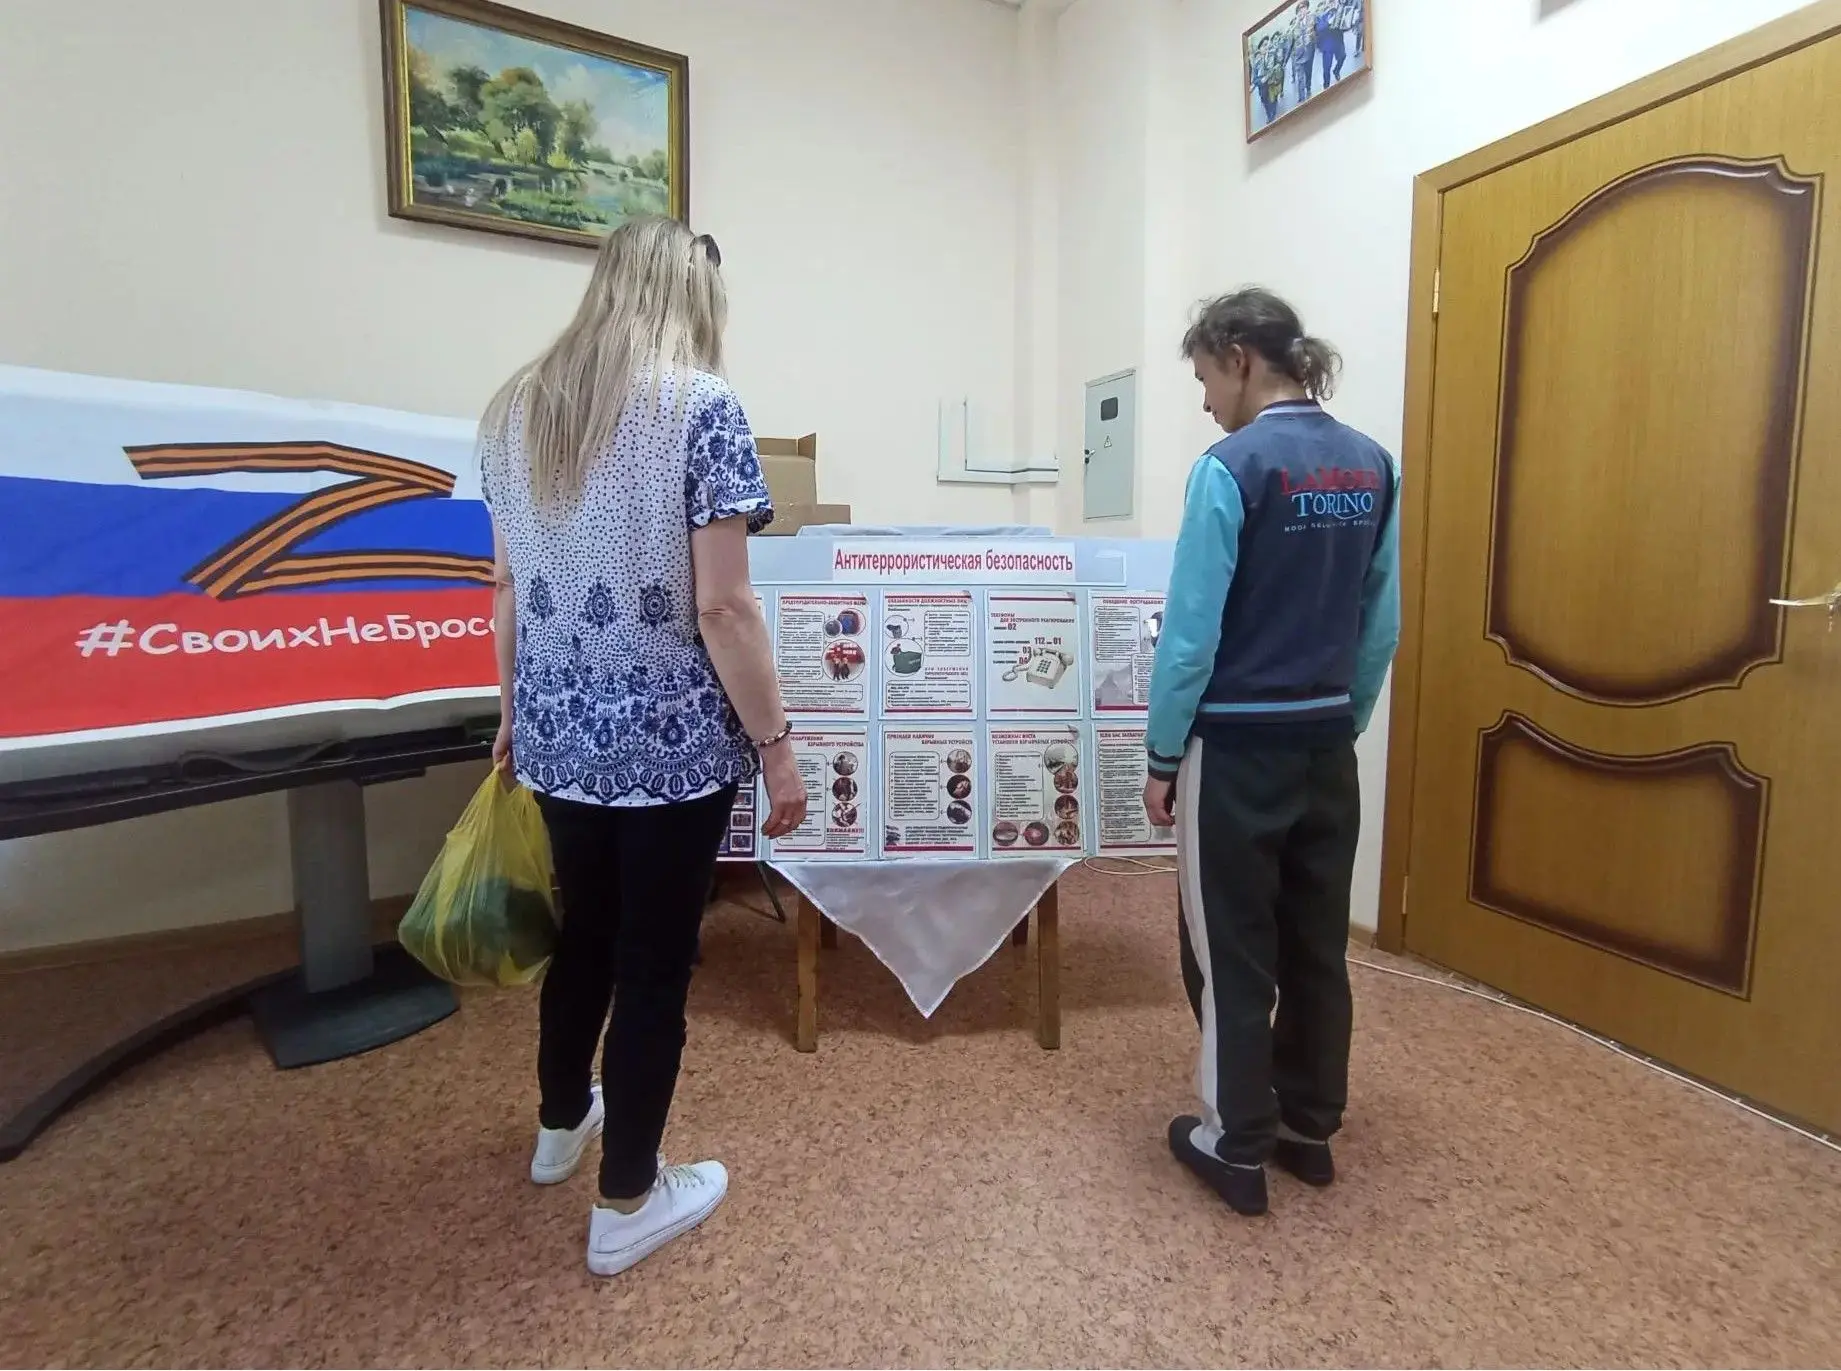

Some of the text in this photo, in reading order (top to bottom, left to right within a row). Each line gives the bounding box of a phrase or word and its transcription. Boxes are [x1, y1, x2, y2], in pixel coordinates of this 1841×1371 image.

[1291, 491, 1373, 519] TORINO
[834, 548, 1073, 575] Антитеррористическая безопасность
[1007, 622, 1017, 631] 02
[1034, 636, 1046, 645] 112
[1053, 636, 1062, 645] 01
